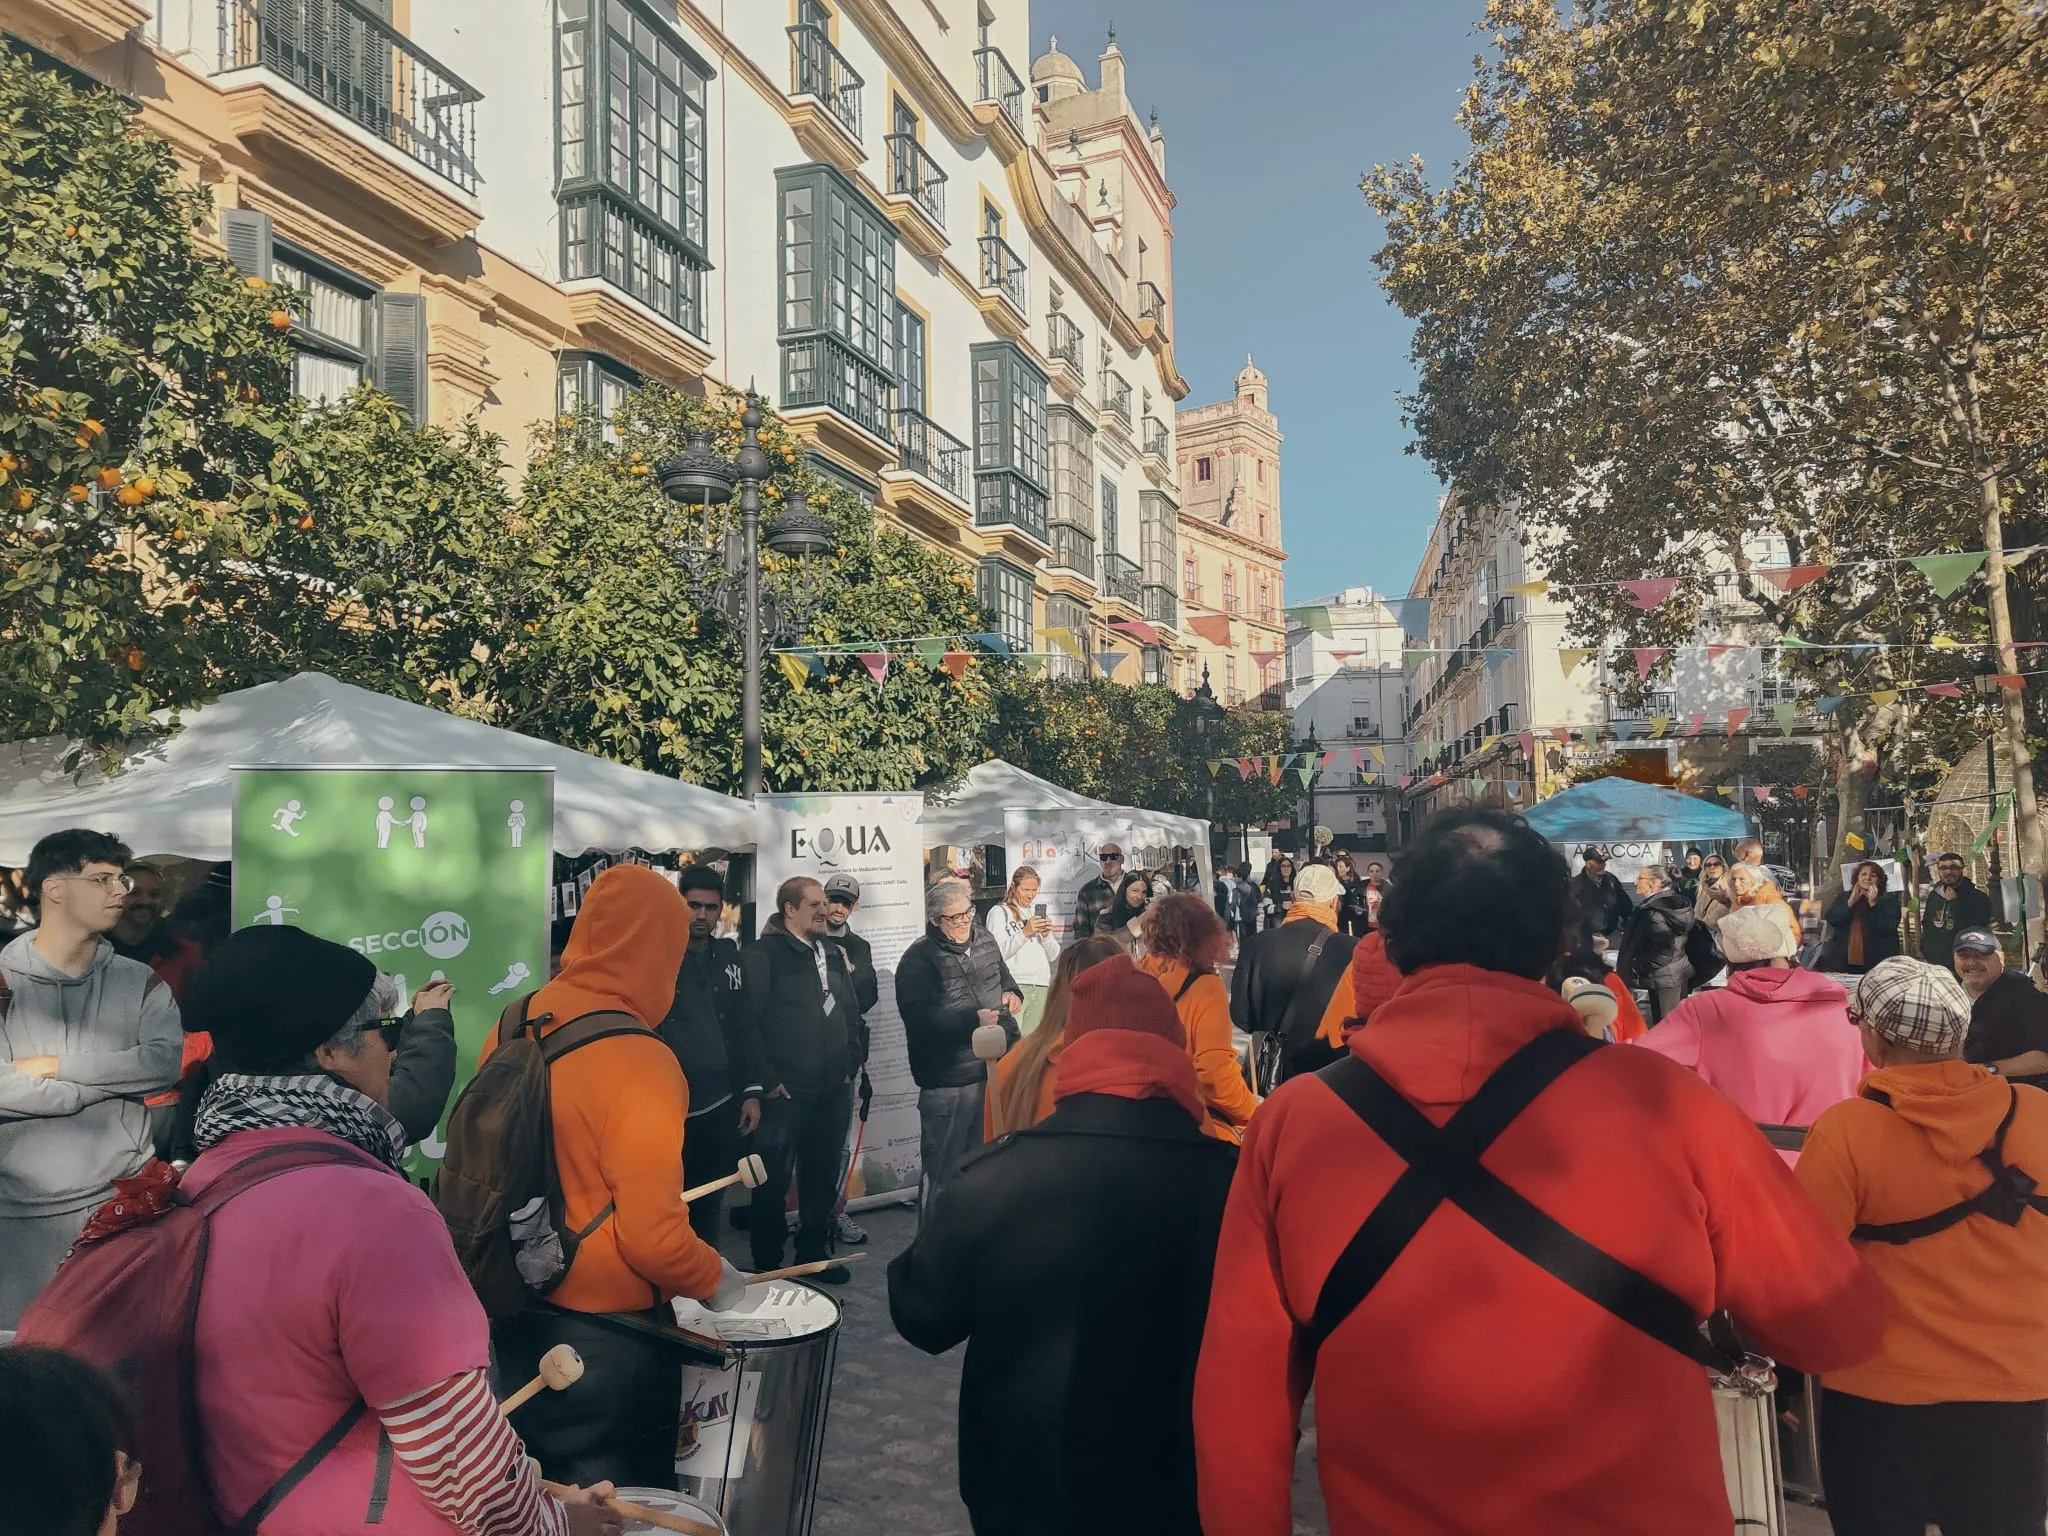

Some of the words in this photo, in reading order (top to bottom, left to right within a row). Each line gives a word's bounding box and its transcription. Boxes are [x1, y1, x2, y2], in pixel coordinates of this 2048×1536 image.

[791, 825, 891, 867] EQUA
[1573, 843, 1655, 859] AACCA
[348, 920, 469, 954] SECCIÓN
[725, 963, 742, 991] NY
